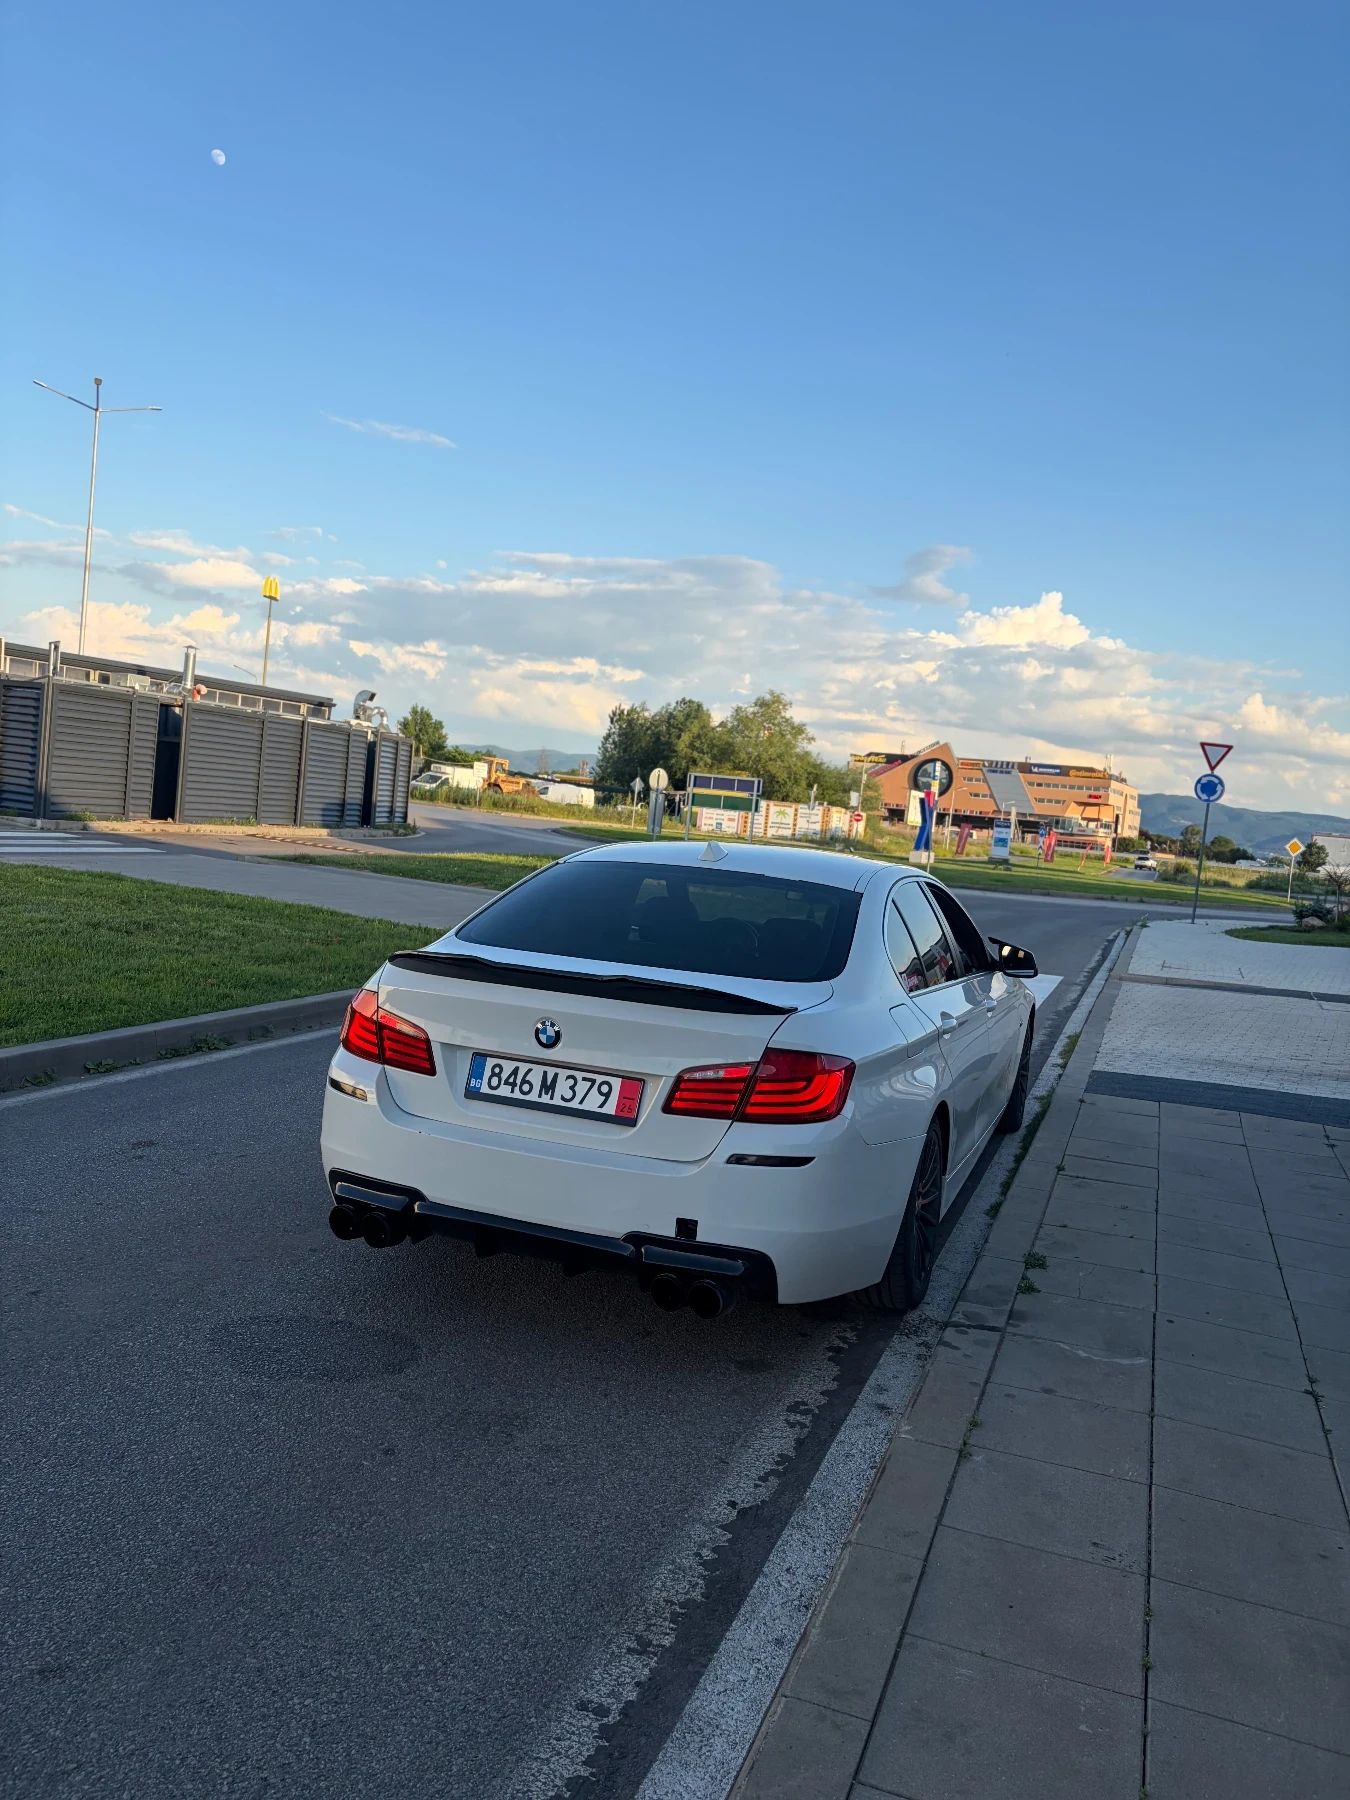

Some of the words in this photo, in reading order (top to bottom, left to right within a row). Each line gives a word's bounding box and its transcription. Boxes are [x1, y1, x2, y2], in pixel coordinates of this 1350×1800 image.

[537, 1020, 560, 1031] BMW
[470, 1079, 481, 1088] BG
[619, 1103, 633, 1113] 26
